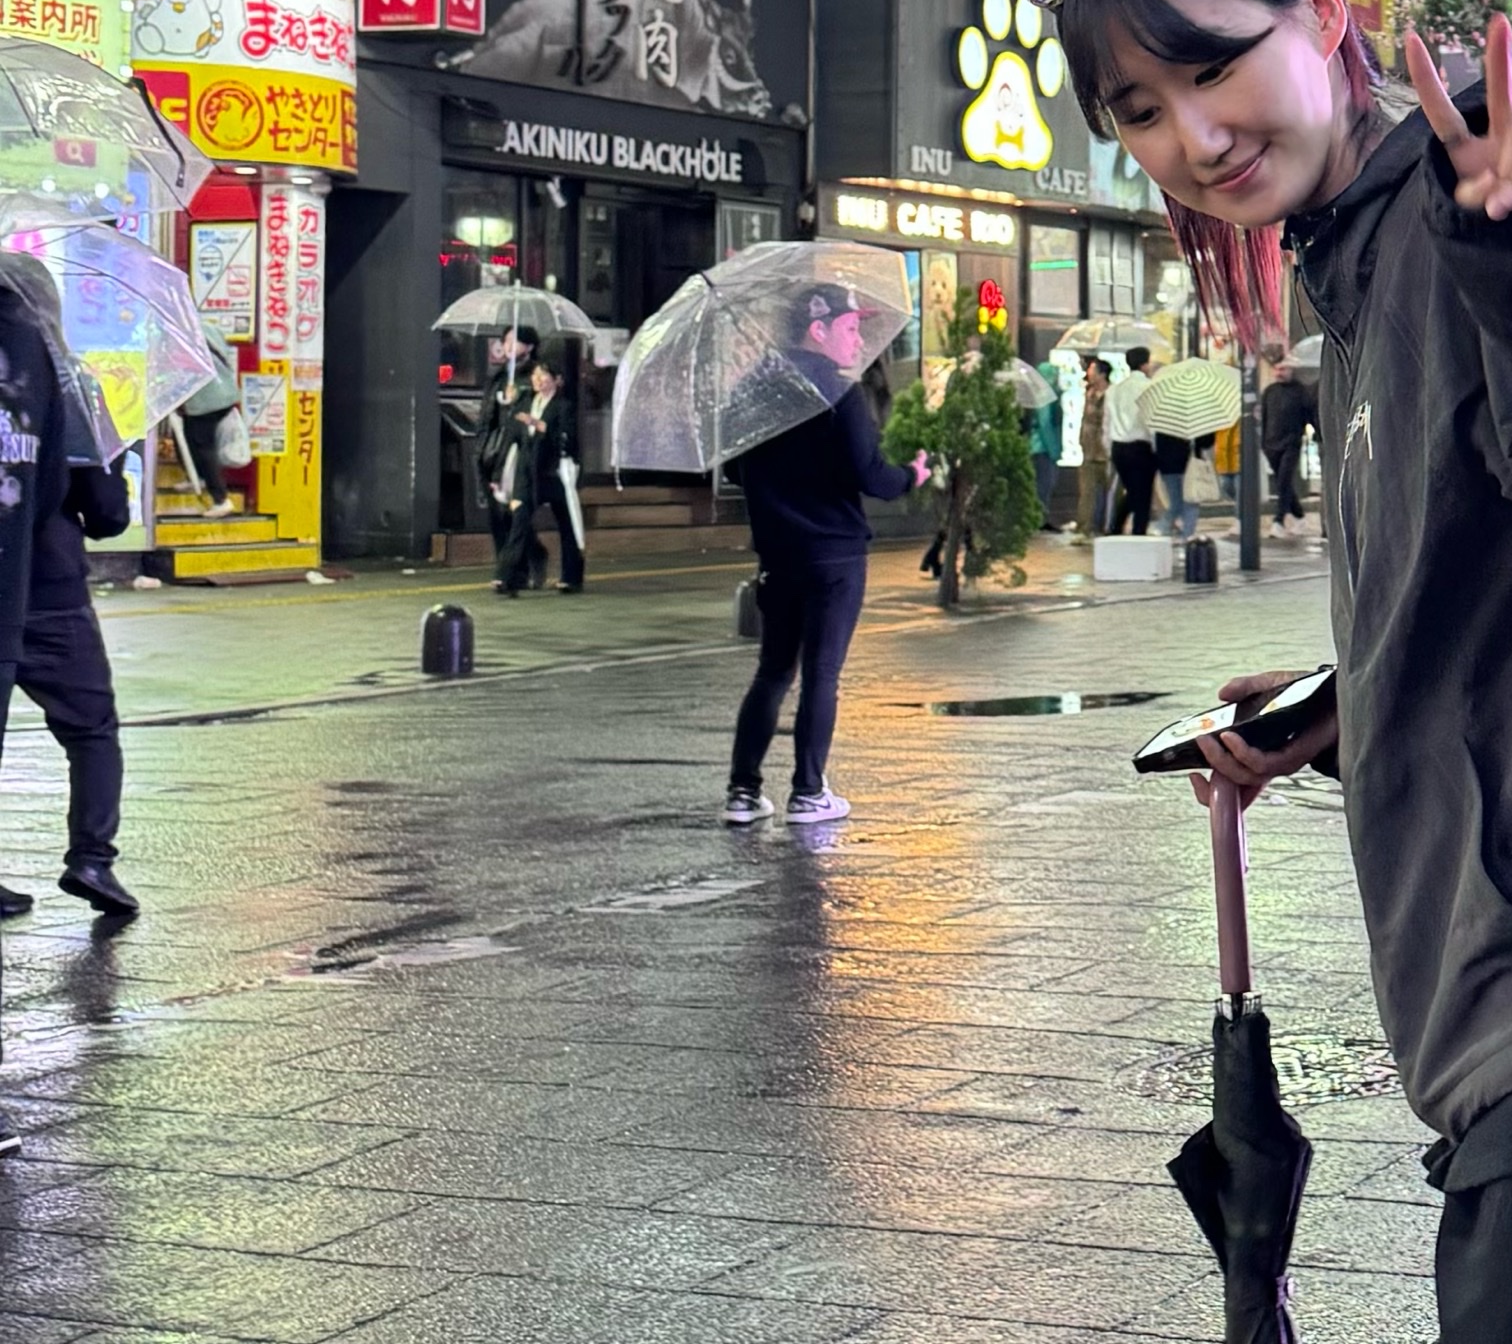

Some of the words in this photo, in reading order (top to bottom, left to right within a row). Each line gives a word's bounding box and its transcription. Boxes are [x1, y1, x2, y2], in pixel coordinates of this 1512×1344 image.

[266, 86, 337, 124] やきとり
[267, 122, 341, 156] センター
[496, 119, 608, 165] AKINIKU
[613, 136, 742, 182] BLACKHOLE
[911, 145, 952, 176] INU
[1036, 167, 1087, 195] CAFE
[896, 202, 964, 242] CAFE
[266, 191, 290, 353] まねきねこ
[298, 205, 321, 341] カラオケ
